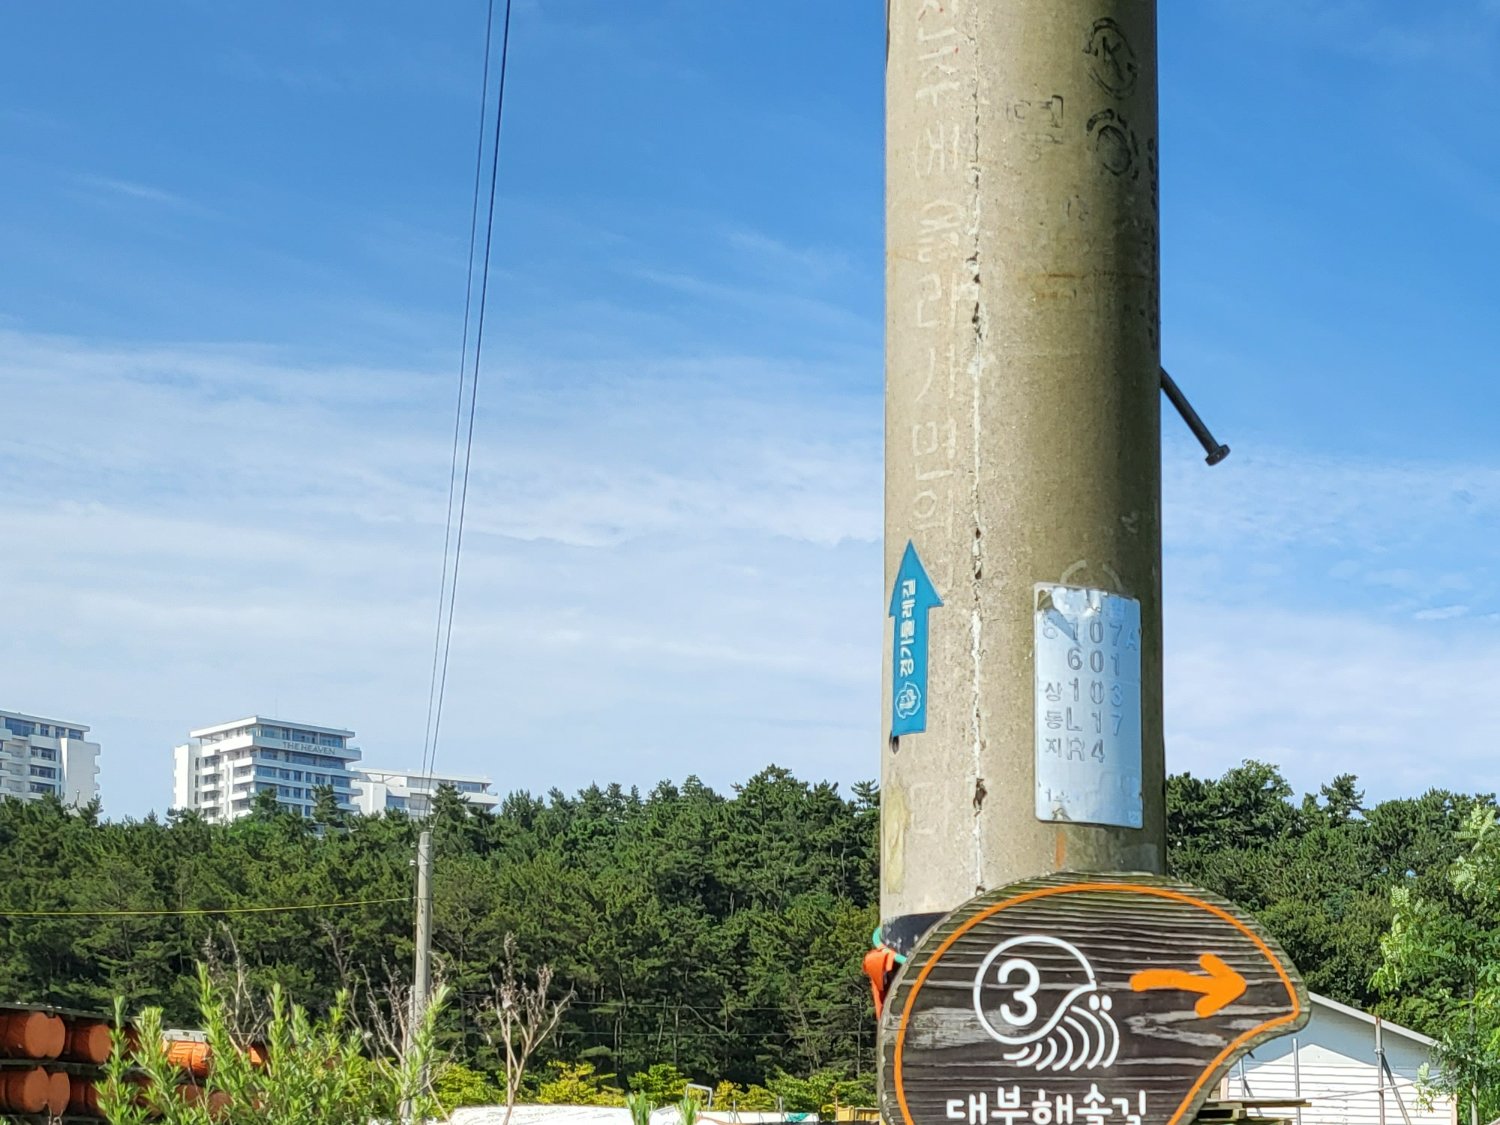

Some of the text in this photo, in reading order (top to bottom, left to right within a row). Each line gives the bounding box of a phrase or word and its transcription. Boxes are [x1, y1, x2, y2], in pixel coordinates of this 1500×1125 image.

[900, 578, 916, 678] 경기둘레길
[1067, 647, 1120, 676] 601
[283, 742, 335, 754] THE HEAVEN
[997, 958, 1040, 1026] 3
